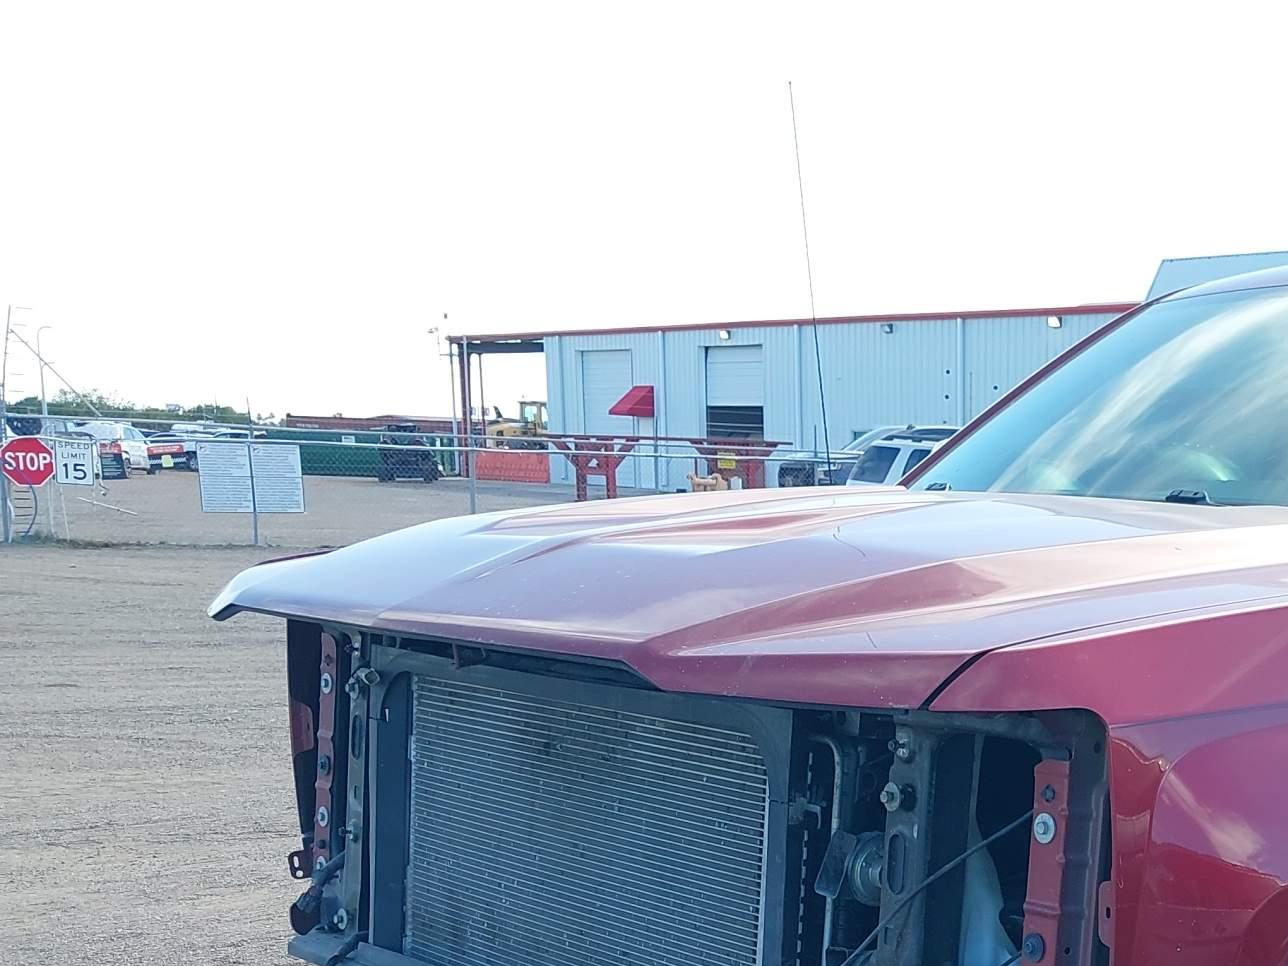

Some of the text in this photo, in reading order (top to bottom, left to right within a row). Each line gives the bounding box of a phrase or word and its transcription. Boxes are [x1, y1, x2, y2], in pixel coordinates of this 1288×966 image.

[57, 441, 90, 450] SPEED
[4, 451, 51, 471] STOP
[61, 451, 87, 460] LIMIT
[62, 463, 87, 481] 15
